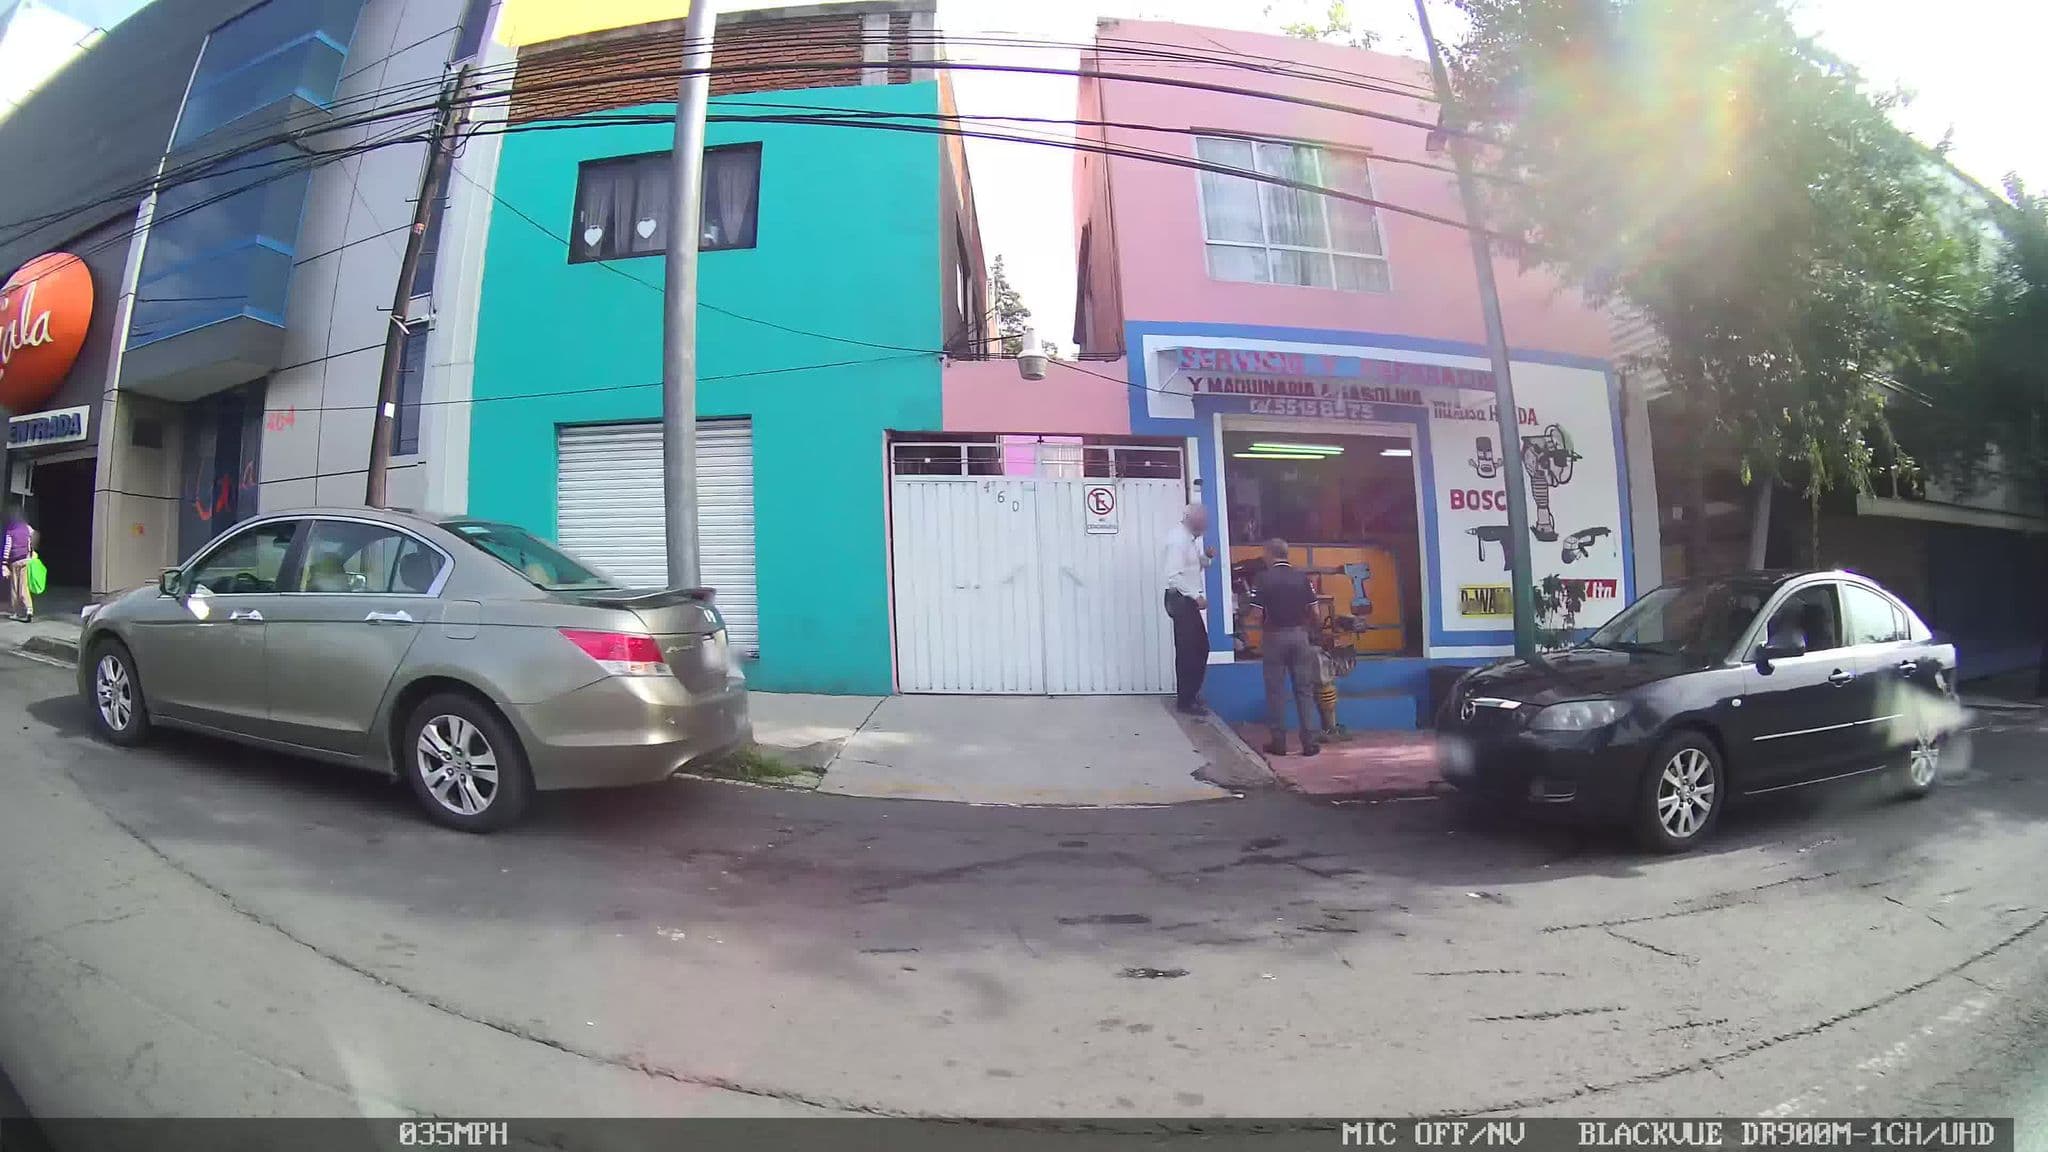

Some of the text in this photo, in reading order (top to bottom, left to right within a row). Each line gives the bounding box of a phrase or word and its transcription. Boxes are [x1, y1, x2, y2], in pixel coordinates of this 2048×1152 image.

[1187, 377, 1203, 394] Y
[1208, 377, 1315, 397] MAQUINARIA
[1450, 489, 1507, 512] BOSC
